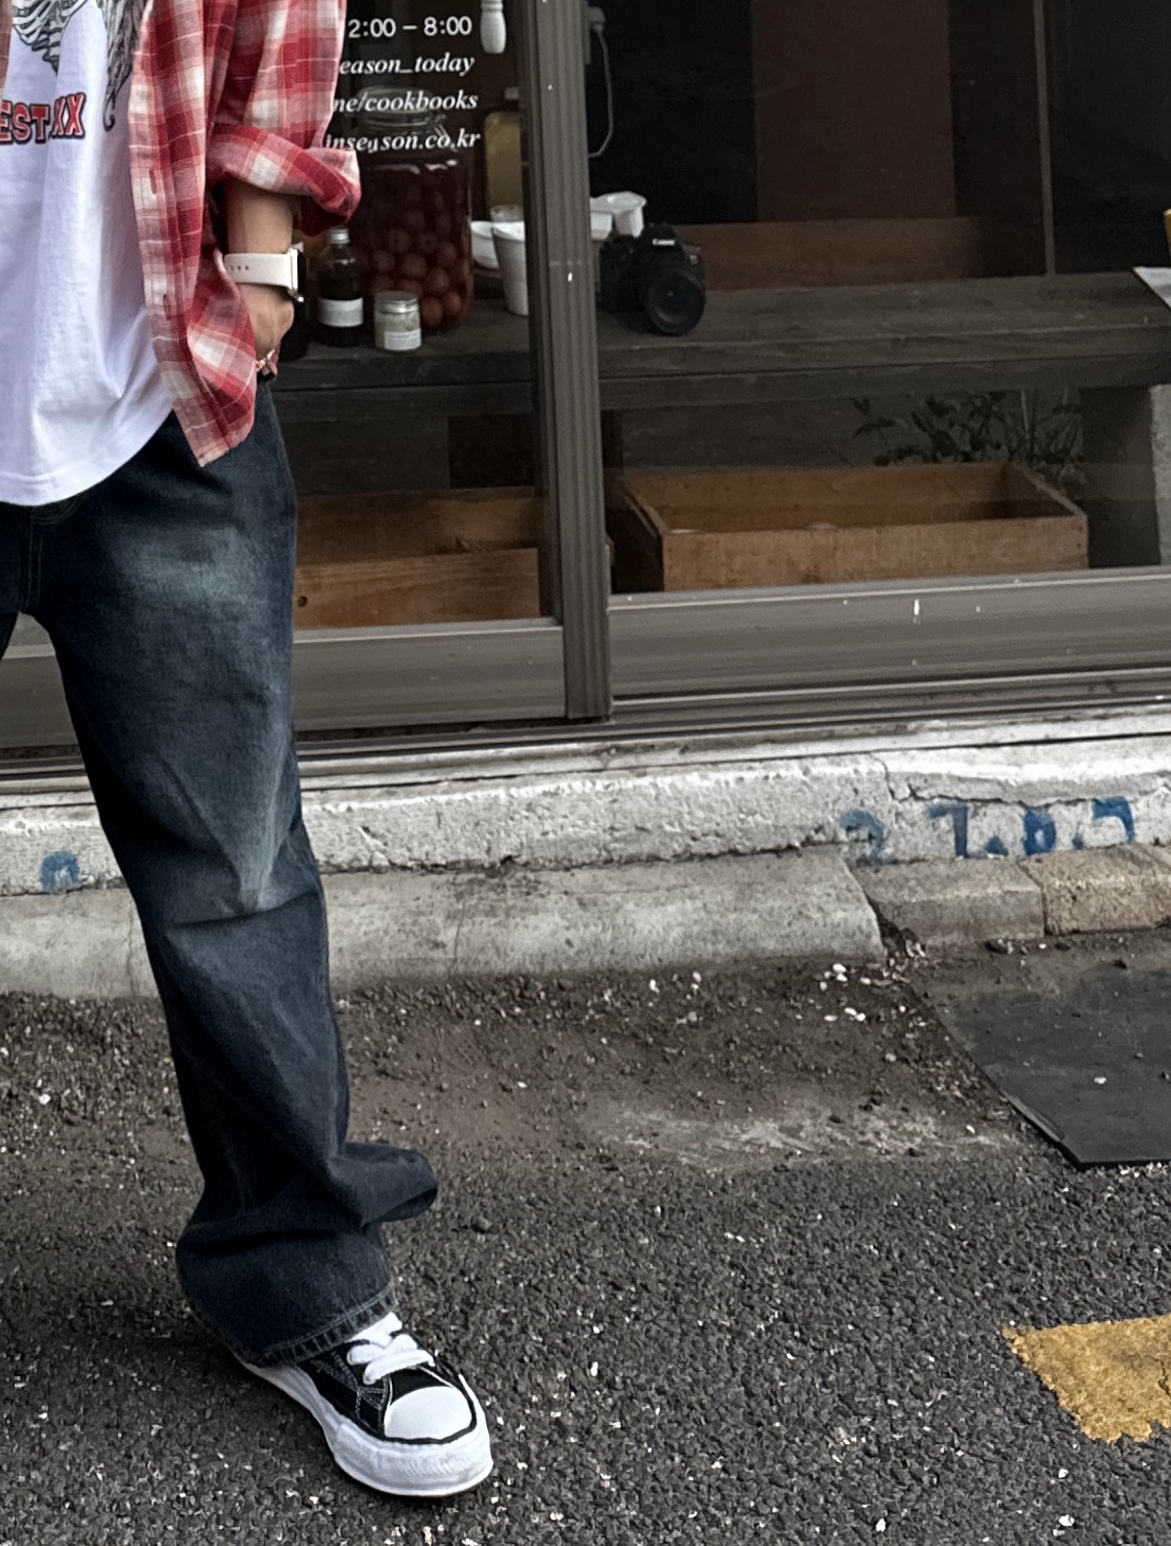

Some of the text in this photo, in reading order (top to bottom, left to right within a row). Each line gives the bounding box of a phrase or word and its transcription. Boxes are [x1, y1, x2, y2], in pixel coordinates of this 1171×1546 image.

[348, 17, 397, 39] 2:00
[423, 15, 473, 37] 8:00
[339, 51, 476, 78] eason_today
